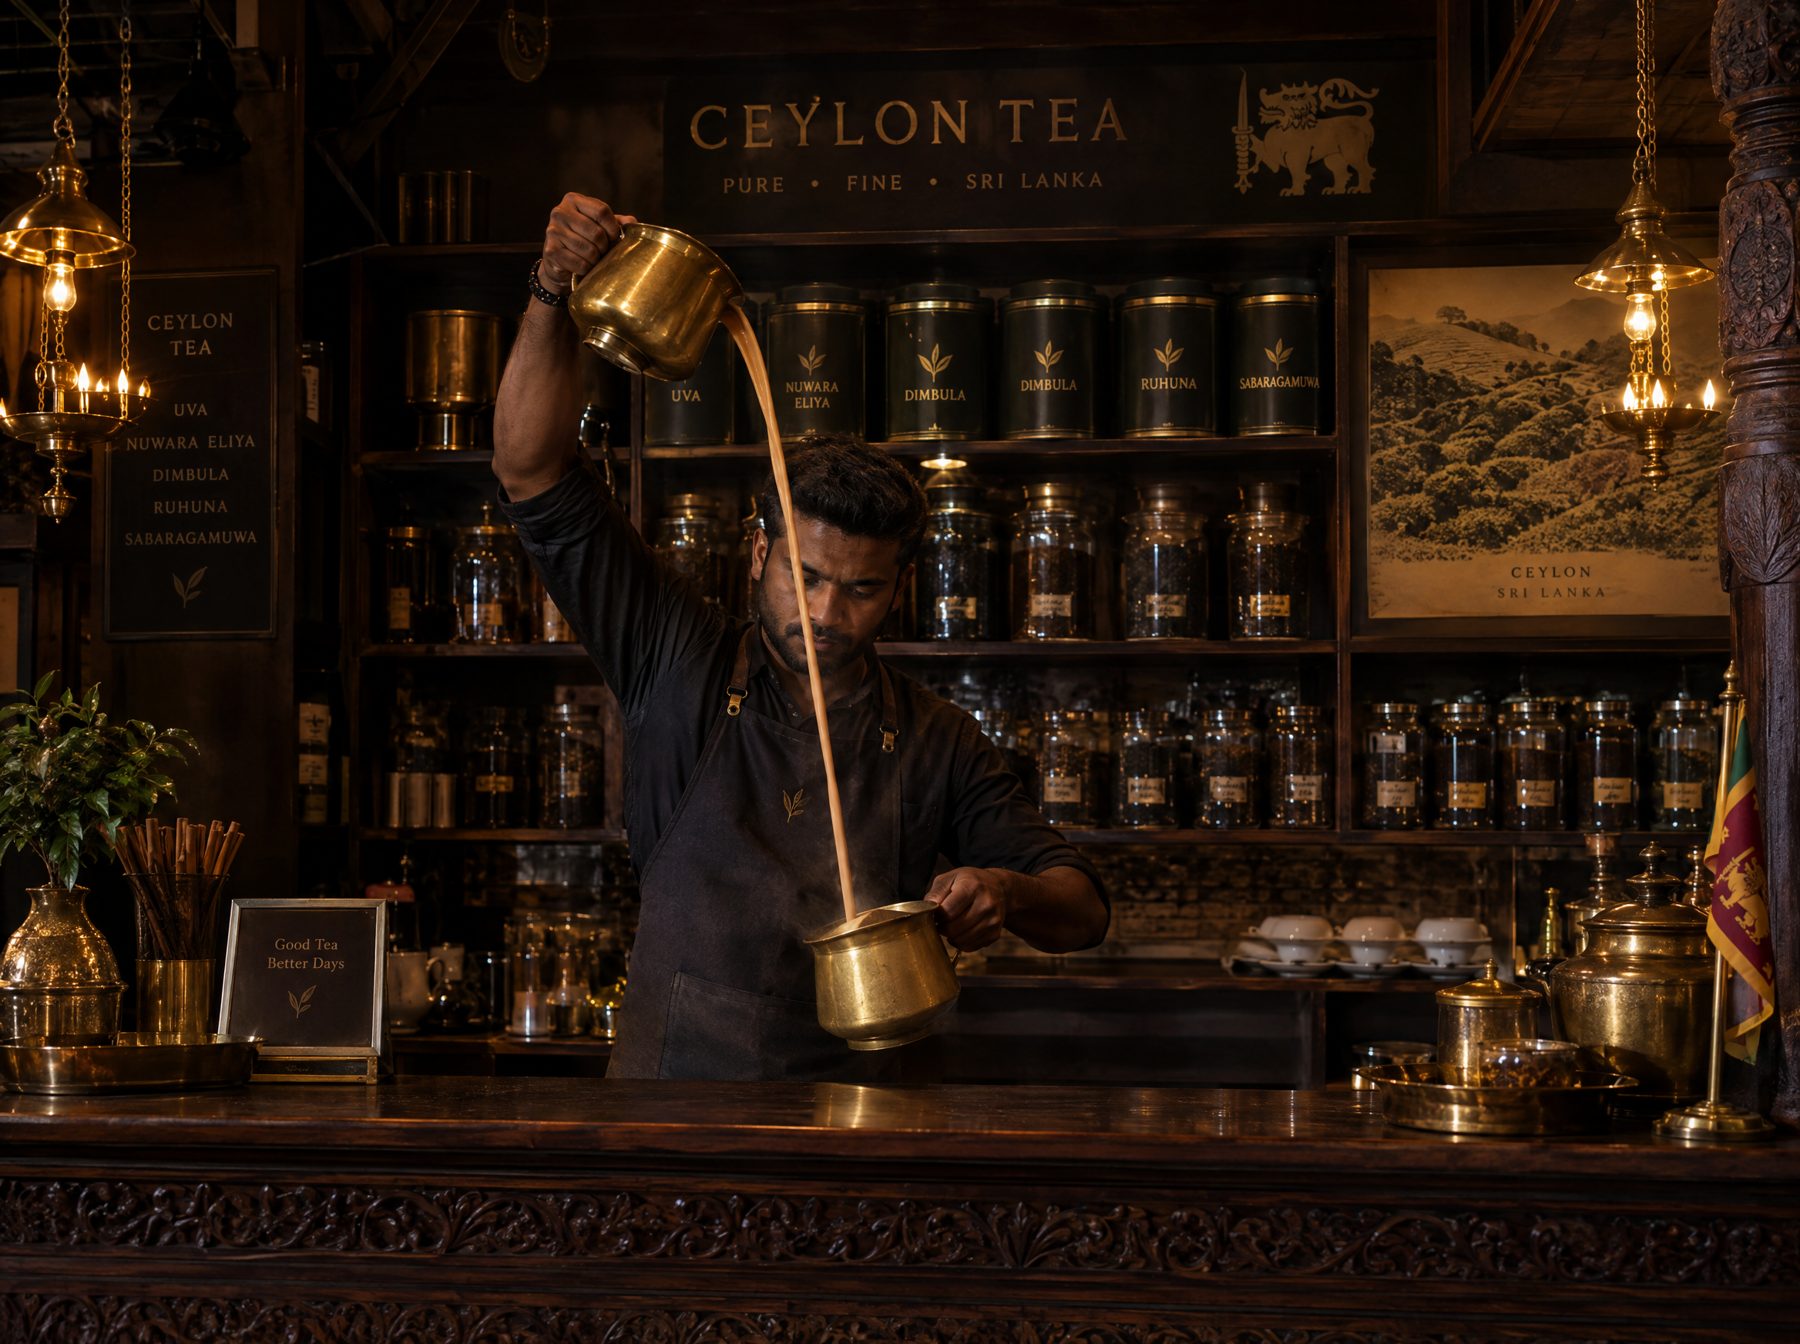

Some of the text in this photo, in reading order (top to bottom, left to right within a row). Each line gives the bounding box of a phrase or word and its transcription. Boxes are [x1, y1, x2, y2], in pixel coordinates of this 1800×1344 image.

[690, 97, 1129, 150] CEYLON TEA
[723, 172, 1104, 193] PURE FINE SRI LANKA
[147, 312, 234, 331] CEYLON
[169, 339, 212, 356] TEA
[786, 381, 839, 393] NUWARA
[1020, 378, 1078, 391] DIMBULA
[1141, 377, 1198, 391] RUHUNA
[1240, 375, 1321, 390] SABARAGAMUWA
[671, 390, 702, 402] UVA
[905, 389, 967, 402] DIMBULA
[174, 403, 208, 417] UVA
[795, 397, 831, 409] ELIYA
[126, 435, 255, 450] NUWARA ELIYA
[152, 468, 230, 482] DIMBULA
[153, 500, 229, 514] RUHUNA
[124, 530, 258, 546] SABARAGAMUWA
[1511, 566, 1592, 578] CEYLON
[1497, 586, 1606, 599] SRI LANKA
[274, 938, 338, 950] Good Tea
[267, 957, 345, 972] Better Days
